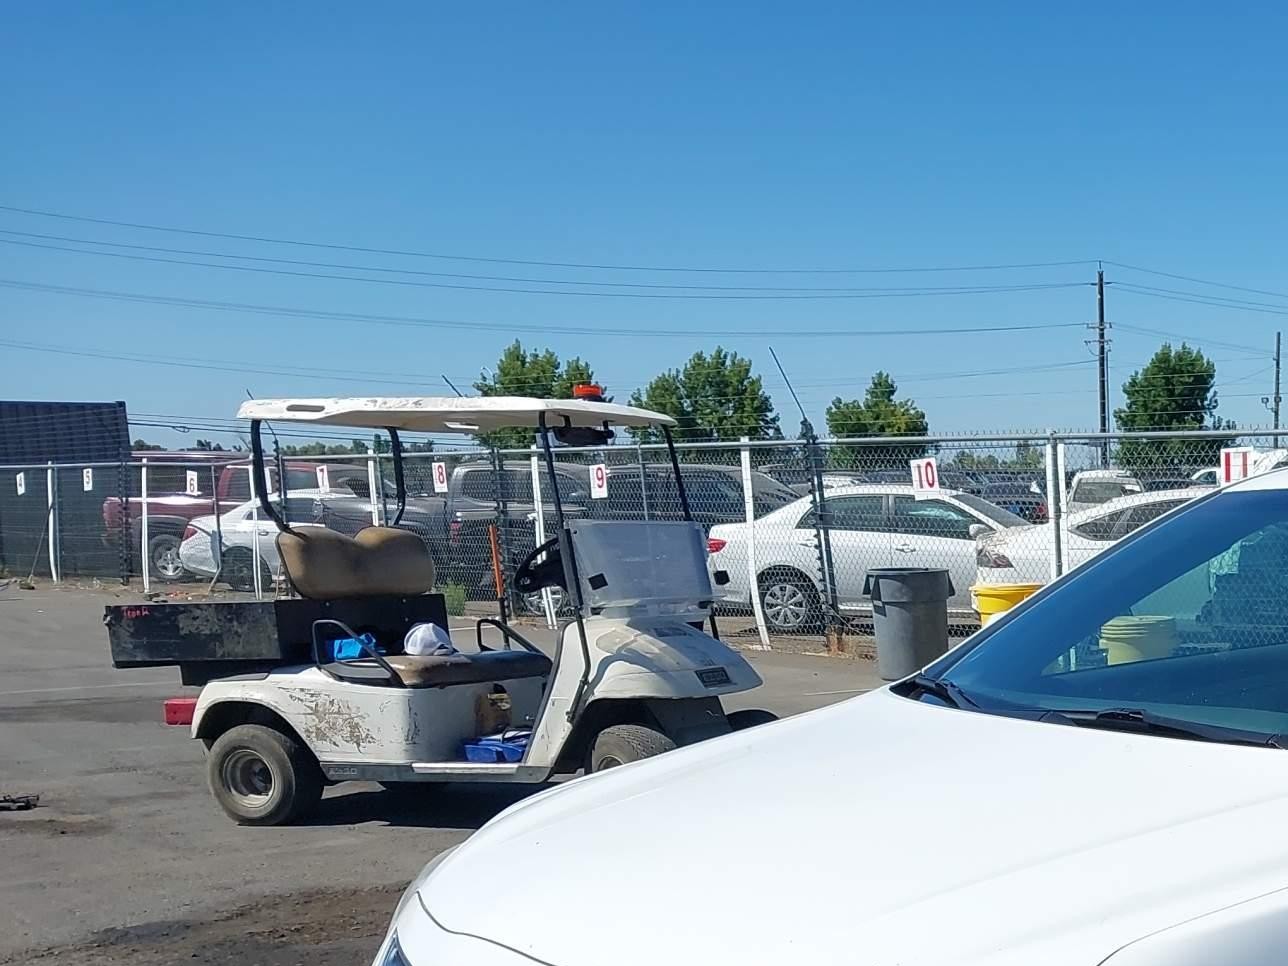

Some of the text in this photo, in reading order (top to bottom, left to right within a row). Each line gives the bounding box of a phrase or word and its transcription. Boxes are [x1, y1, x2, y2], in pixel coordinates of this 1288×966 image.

[85, 469, 91, 485] 5
[318, 467, 326, 487] 7
[437, 464, 445, 485] 8
[596, 466, 605, 489] 9
[917, 461, 935, 489] 10
[189, 477, 195, 493] 6
